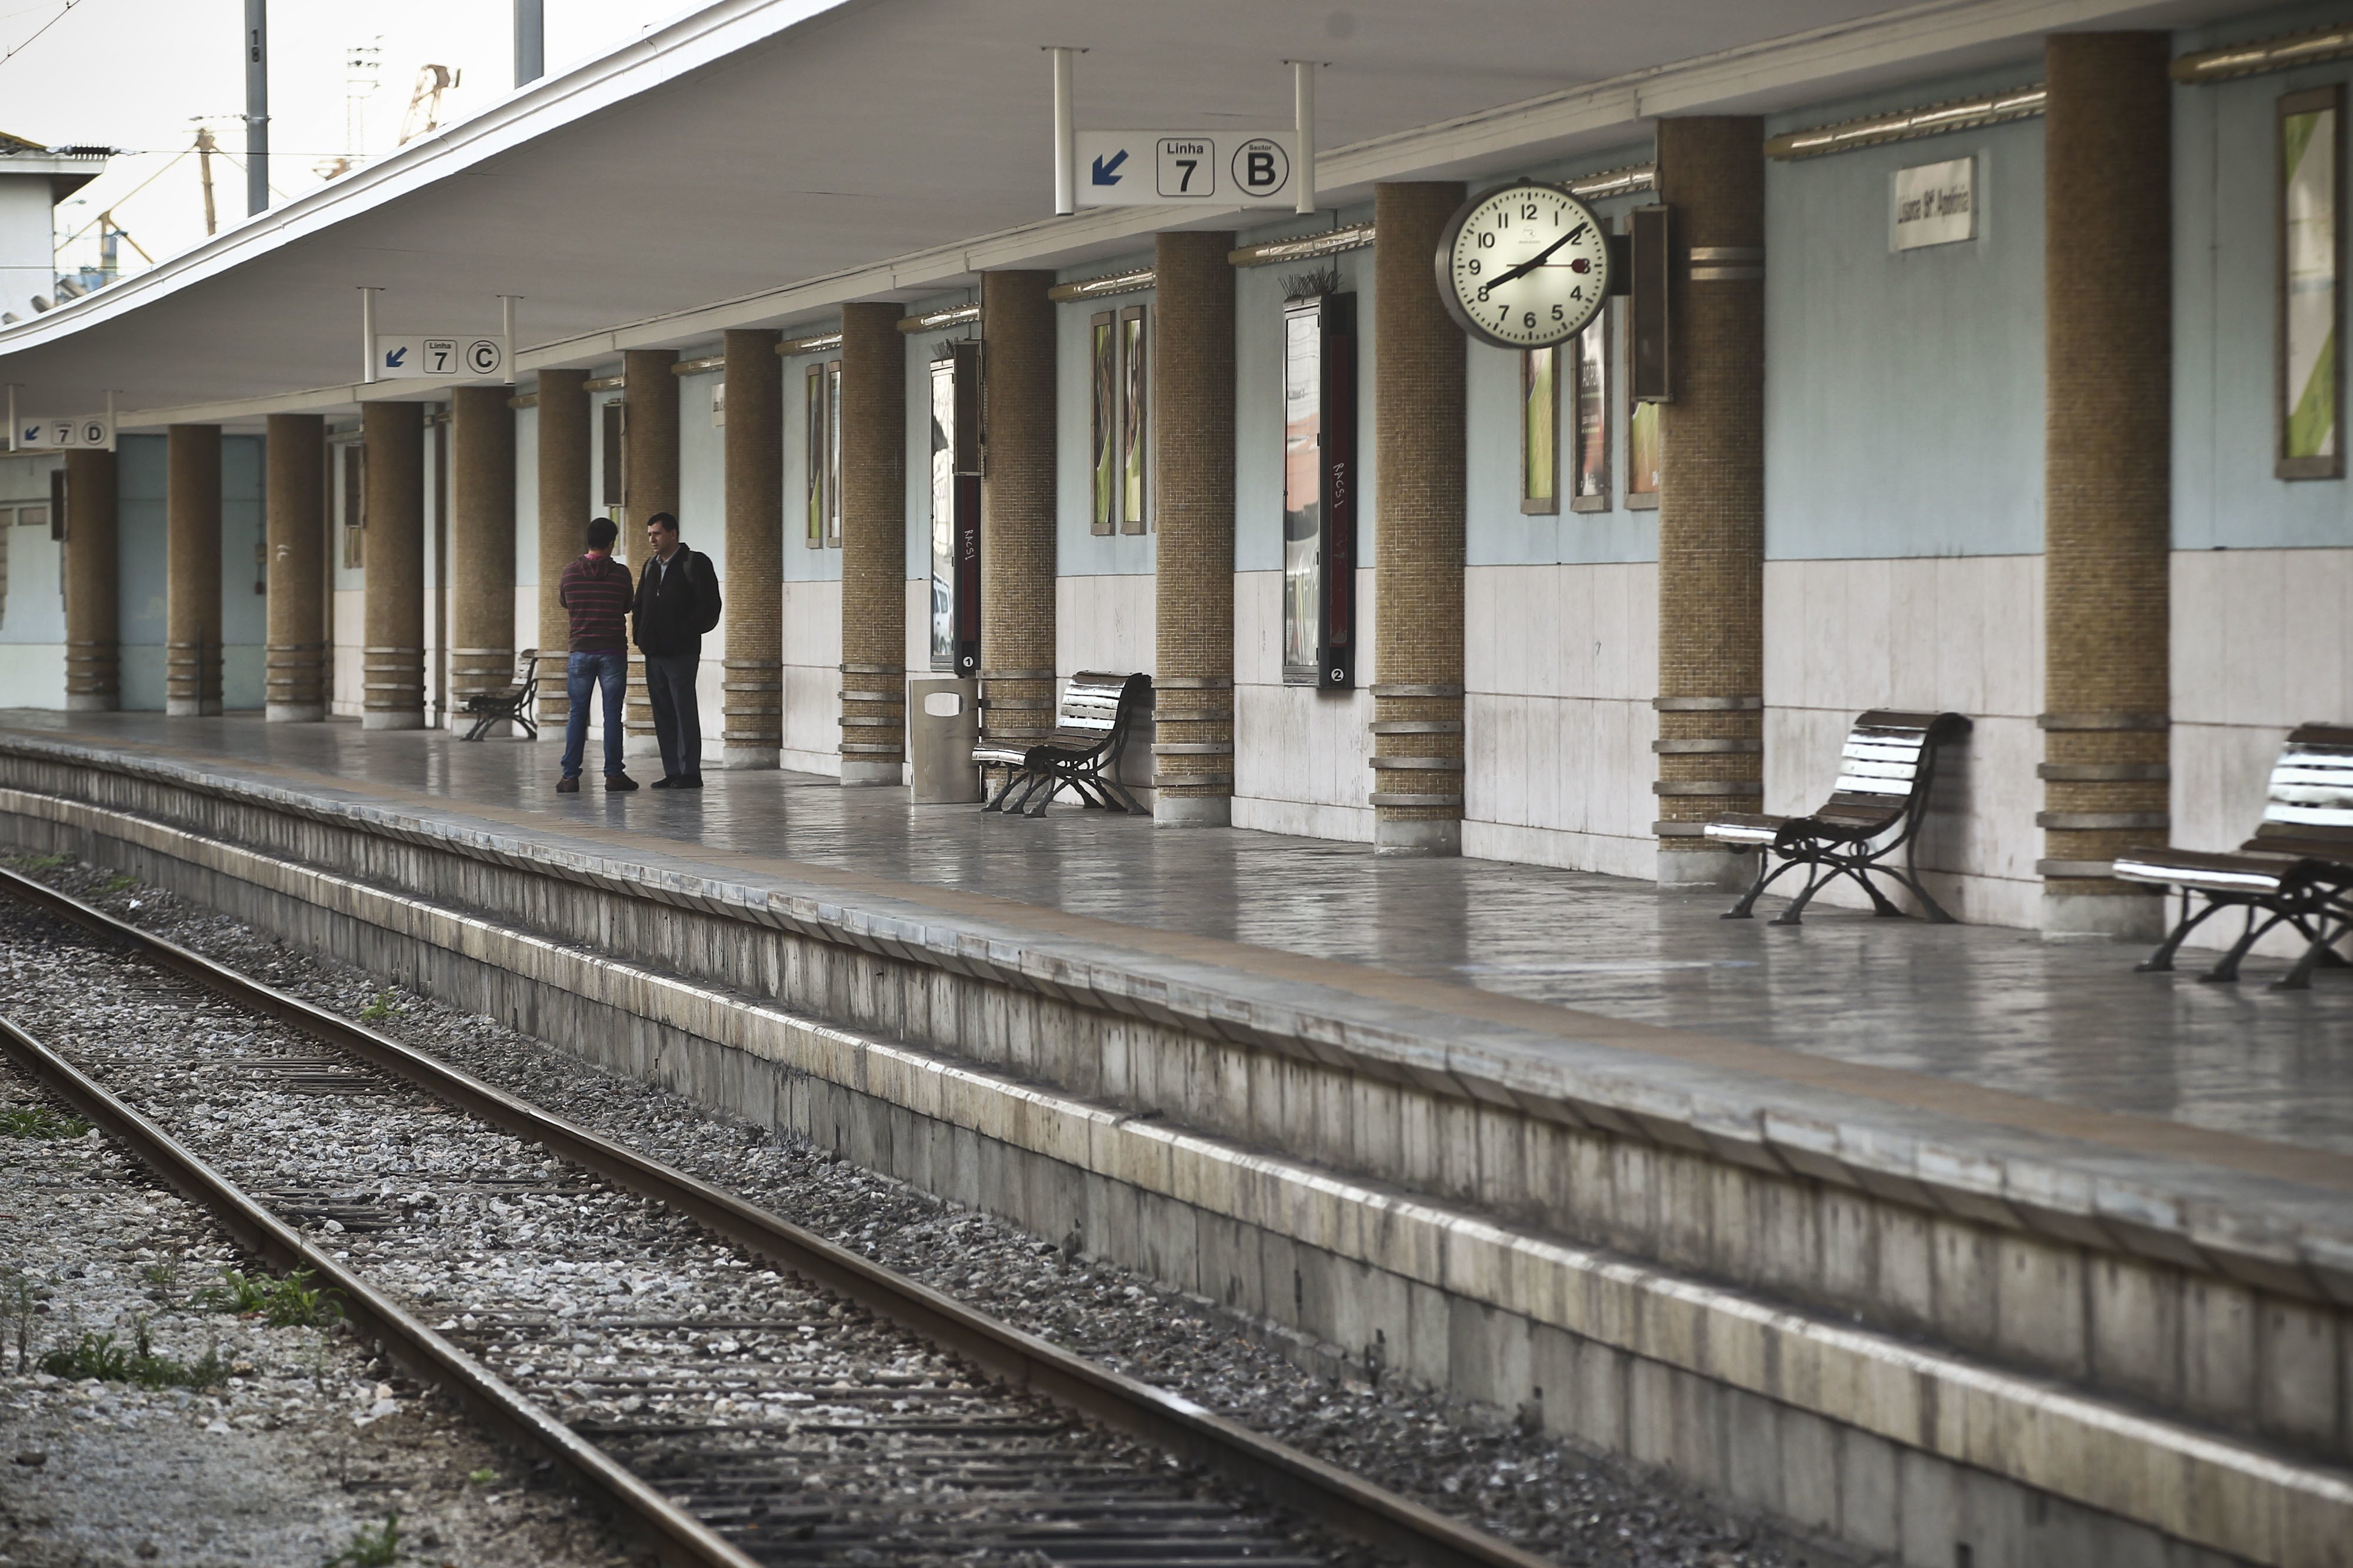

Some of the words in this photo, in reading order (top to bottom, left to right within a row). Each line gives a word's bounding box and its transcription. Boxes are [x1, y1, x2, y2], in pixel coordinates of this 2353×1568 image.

[251, 29, 260, 63] 18
[1167, 142, 1204, 155] Linha
[1176, 159, 1197, 192] 7
[1248, 152, 1276, 186] B
[1498, 212, 1508, 228] 11
[1521, 204, 1538, 220] 12
[1555, 211, 1558, 226] 1
[1478, 232, 1495, 248] 10
[1469, 259, 1481, 275] 9
[1477, 286, 1489, 302] 8
[1570, 285, 1583, 302] 4
[1498, 305, 1510, 321] 7
[1524, 312, 1537, 329] 6
[1551, 304, 1564, 321] 5
[435, 352, 448, 371] 7
[475, 348, 493, 368] C
[59, 429, 69, 443] 7
[88, 426, 101, 441] D
[966, 658, 971, 666] 1
[1334, 670, 1342, 680] 2
